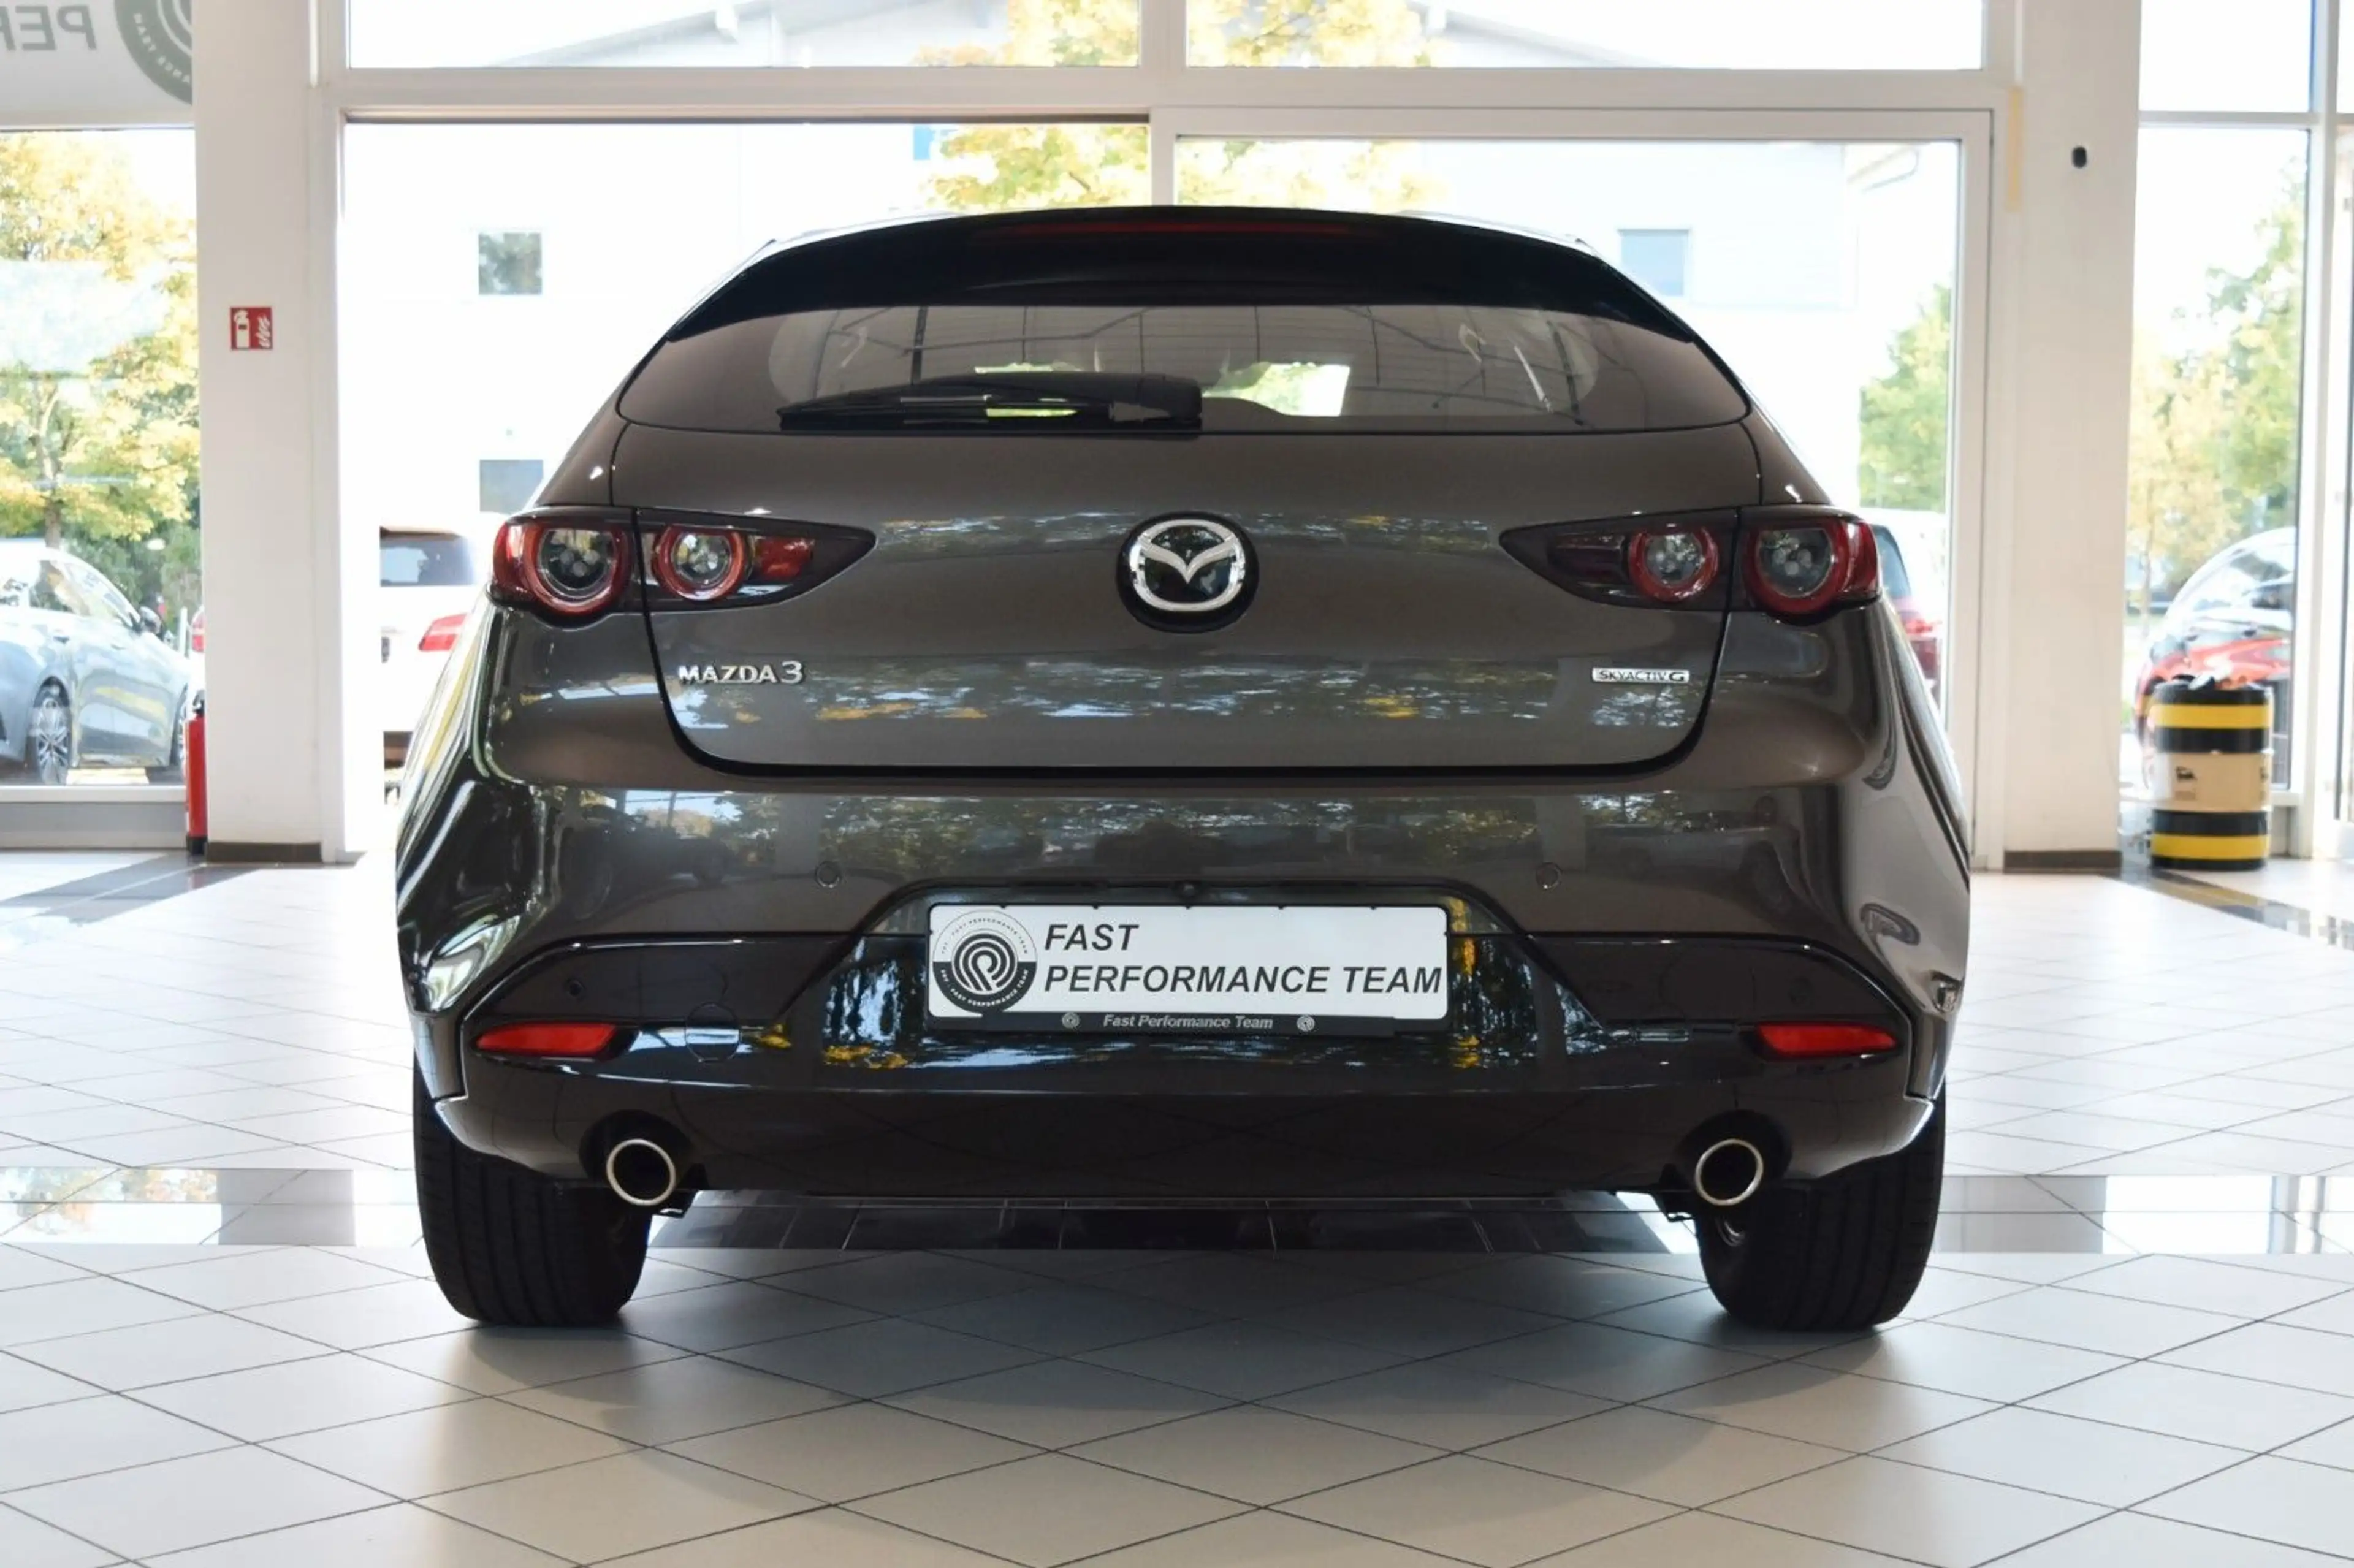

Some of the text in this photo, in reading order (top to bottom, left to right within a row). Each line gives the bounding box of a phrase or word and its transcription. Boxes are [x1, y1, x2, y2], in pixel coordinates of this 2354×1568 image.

[1044, 923, 1139, 951] FAST
[1045, 965, 1442, 993] PERFORMANCE TEAM
[1103, 1015, 1273, 1029] Fast Performance Team
